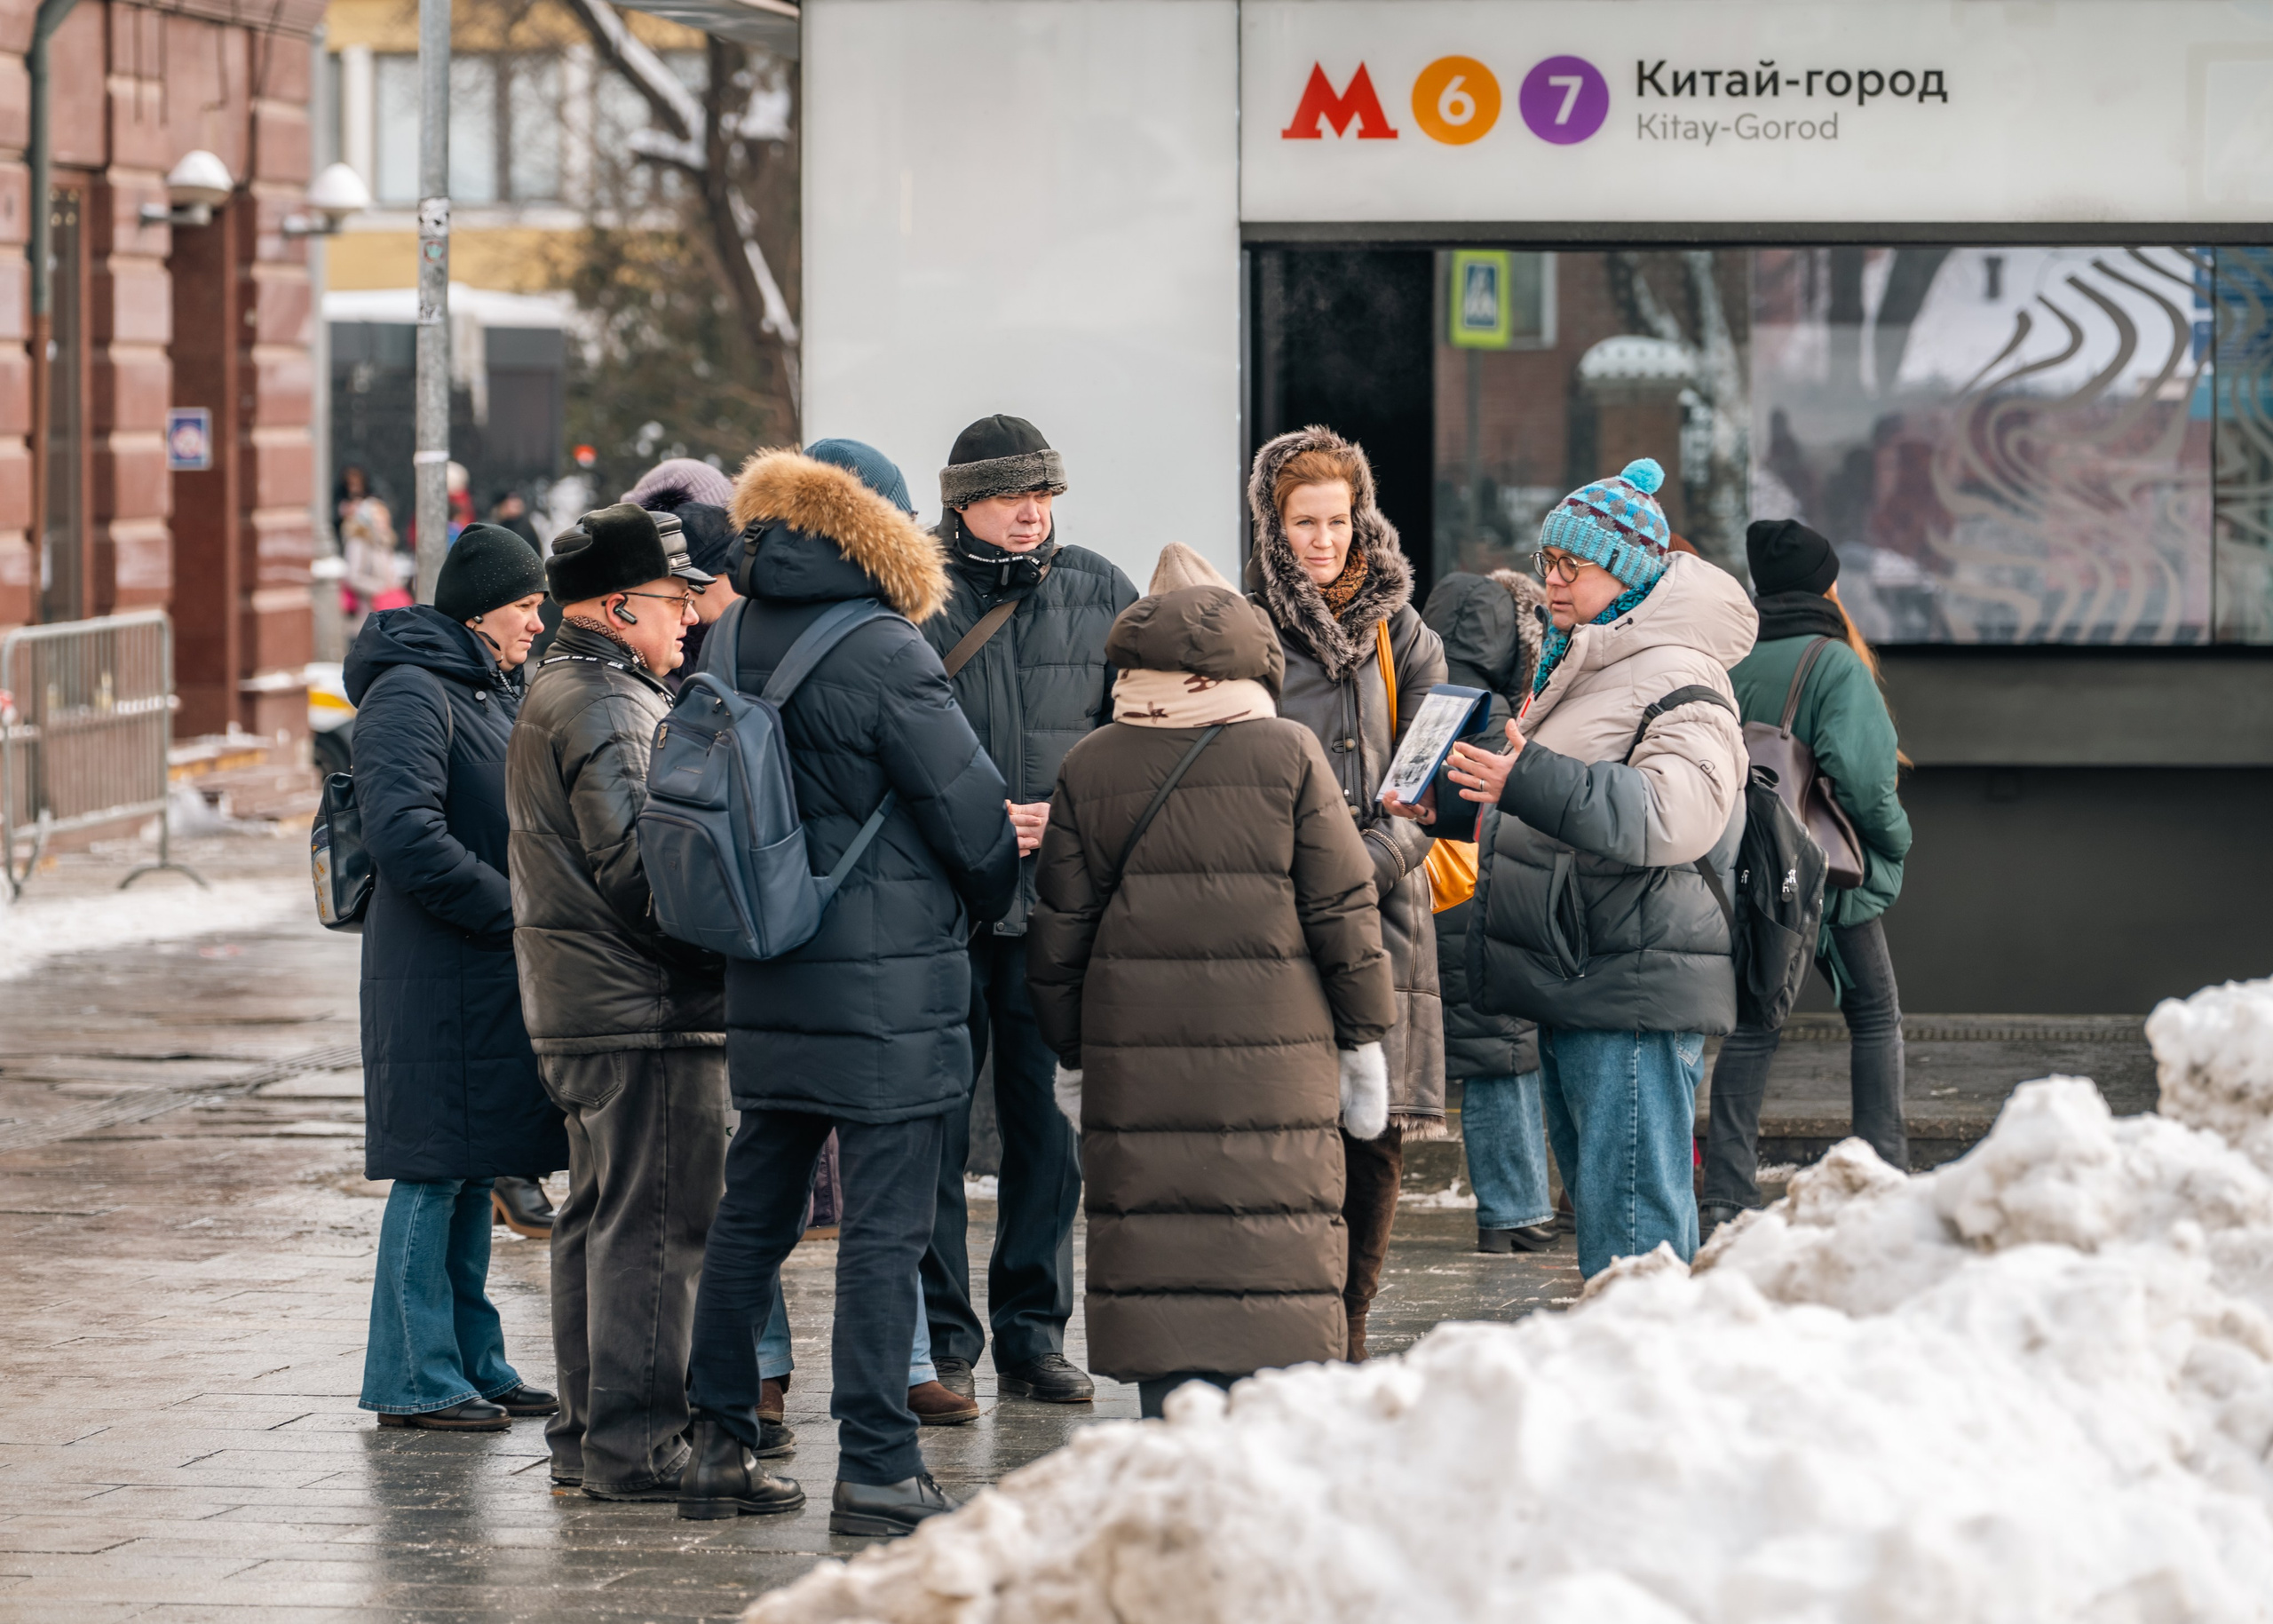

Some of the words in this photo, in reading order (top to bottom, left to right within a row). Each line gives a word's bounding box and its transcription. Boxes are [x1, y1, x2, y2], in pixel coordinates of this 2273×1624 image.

[1438, 75, 1476, 125] 6
[1548, 76, 1583, 125] 7
[1635, 59, 1949, 107] Китай-город
[1635, 111, 1840, 147] Kitay-Gorod
